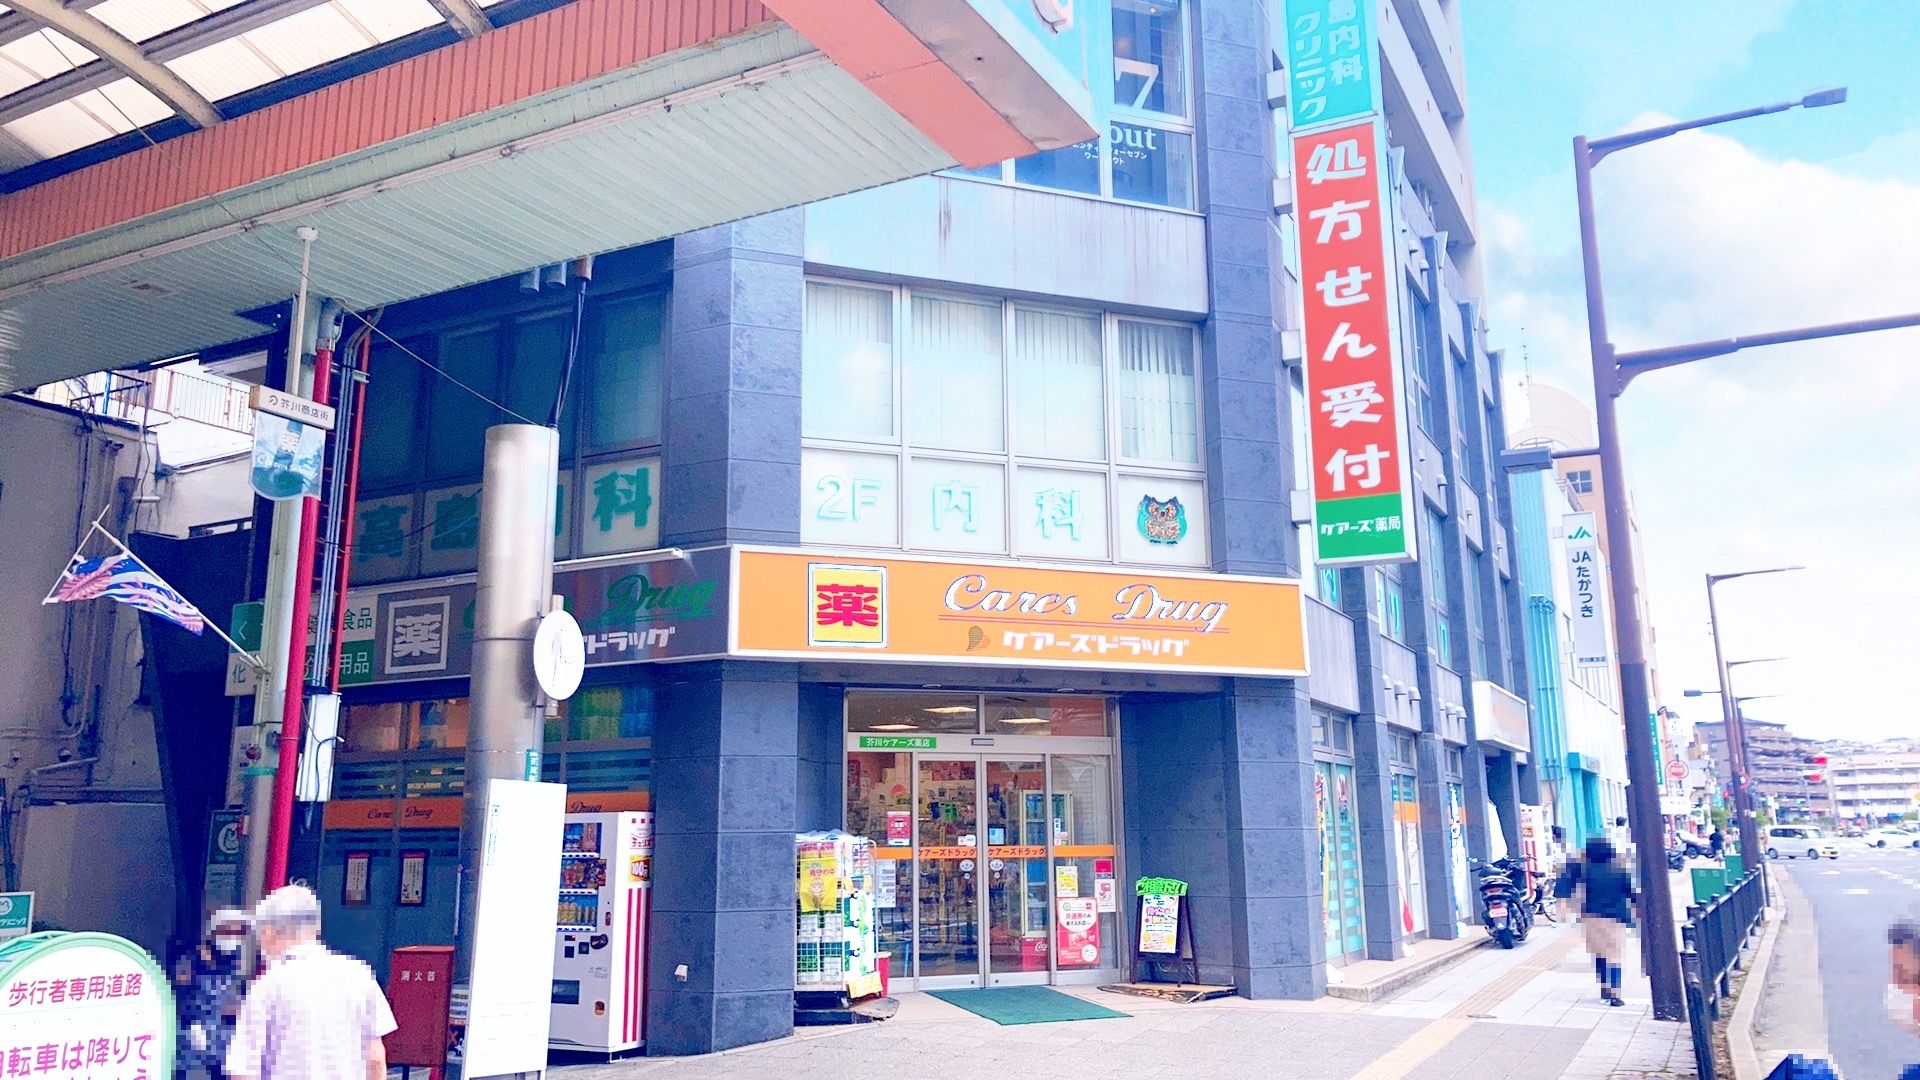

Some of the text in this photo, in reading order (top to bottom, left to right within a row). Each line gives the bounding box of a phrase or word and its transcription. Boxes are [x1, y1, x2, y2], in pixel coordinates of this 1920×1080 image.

[1114, 57, 1159, 109] 7
[1293, 12, 1328, 120] クリニック
[1305, 137, 1392, 495] 処方せん受付
[816, 474, 884, 521] 2F
[606, 574, 719, 624] Drug
[816, 582, 879, 628] 薬
[943, 573, 1230, 633] Cares Drug
[392, 611, 441, 659] 薬
[1001, 628, 1191, 658] ケアーズドラッグ
[987, 846, 1047, 857] ケアーズドラッグ
[8, 972, 143, 1008] 歩行者専用道路
[0, 1034, 152, 1080] 転車は降りて
